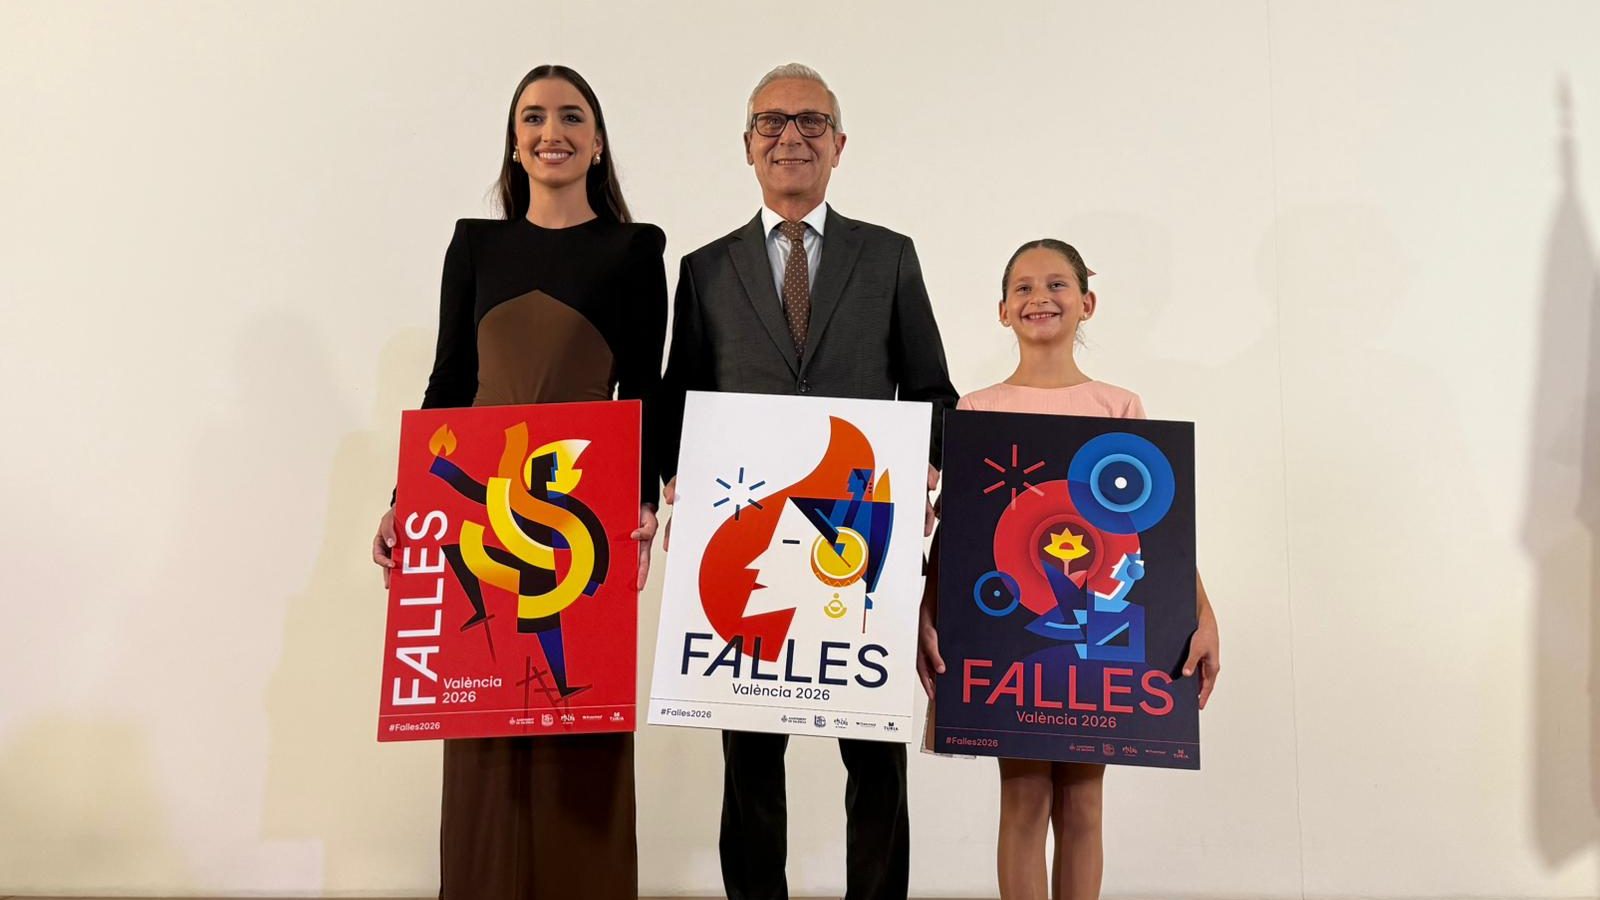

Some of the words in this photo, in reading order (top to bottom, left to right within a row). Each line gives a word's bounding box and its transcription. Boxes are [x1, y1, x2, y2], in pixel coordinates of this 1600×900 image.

[392, 510, 448, 706] FALLES
[680, 632, 889, 688] FALLES
[443, 675, 502, 689] València
[962, 658, 1174, 716] FALLES
[442, 691, 477, 704] 2026
[732, 682, 791, 698] València
[796, 687, 830, 701] 2026
[660, 707, 712, 719] #Falles2026
[1016, 710, 1077, 726] València
[1081, 715, 1117, 729] 2026
[388, 721, 441, 732] #Falles2026
[946, 736, 999, 748] #Falles2026
